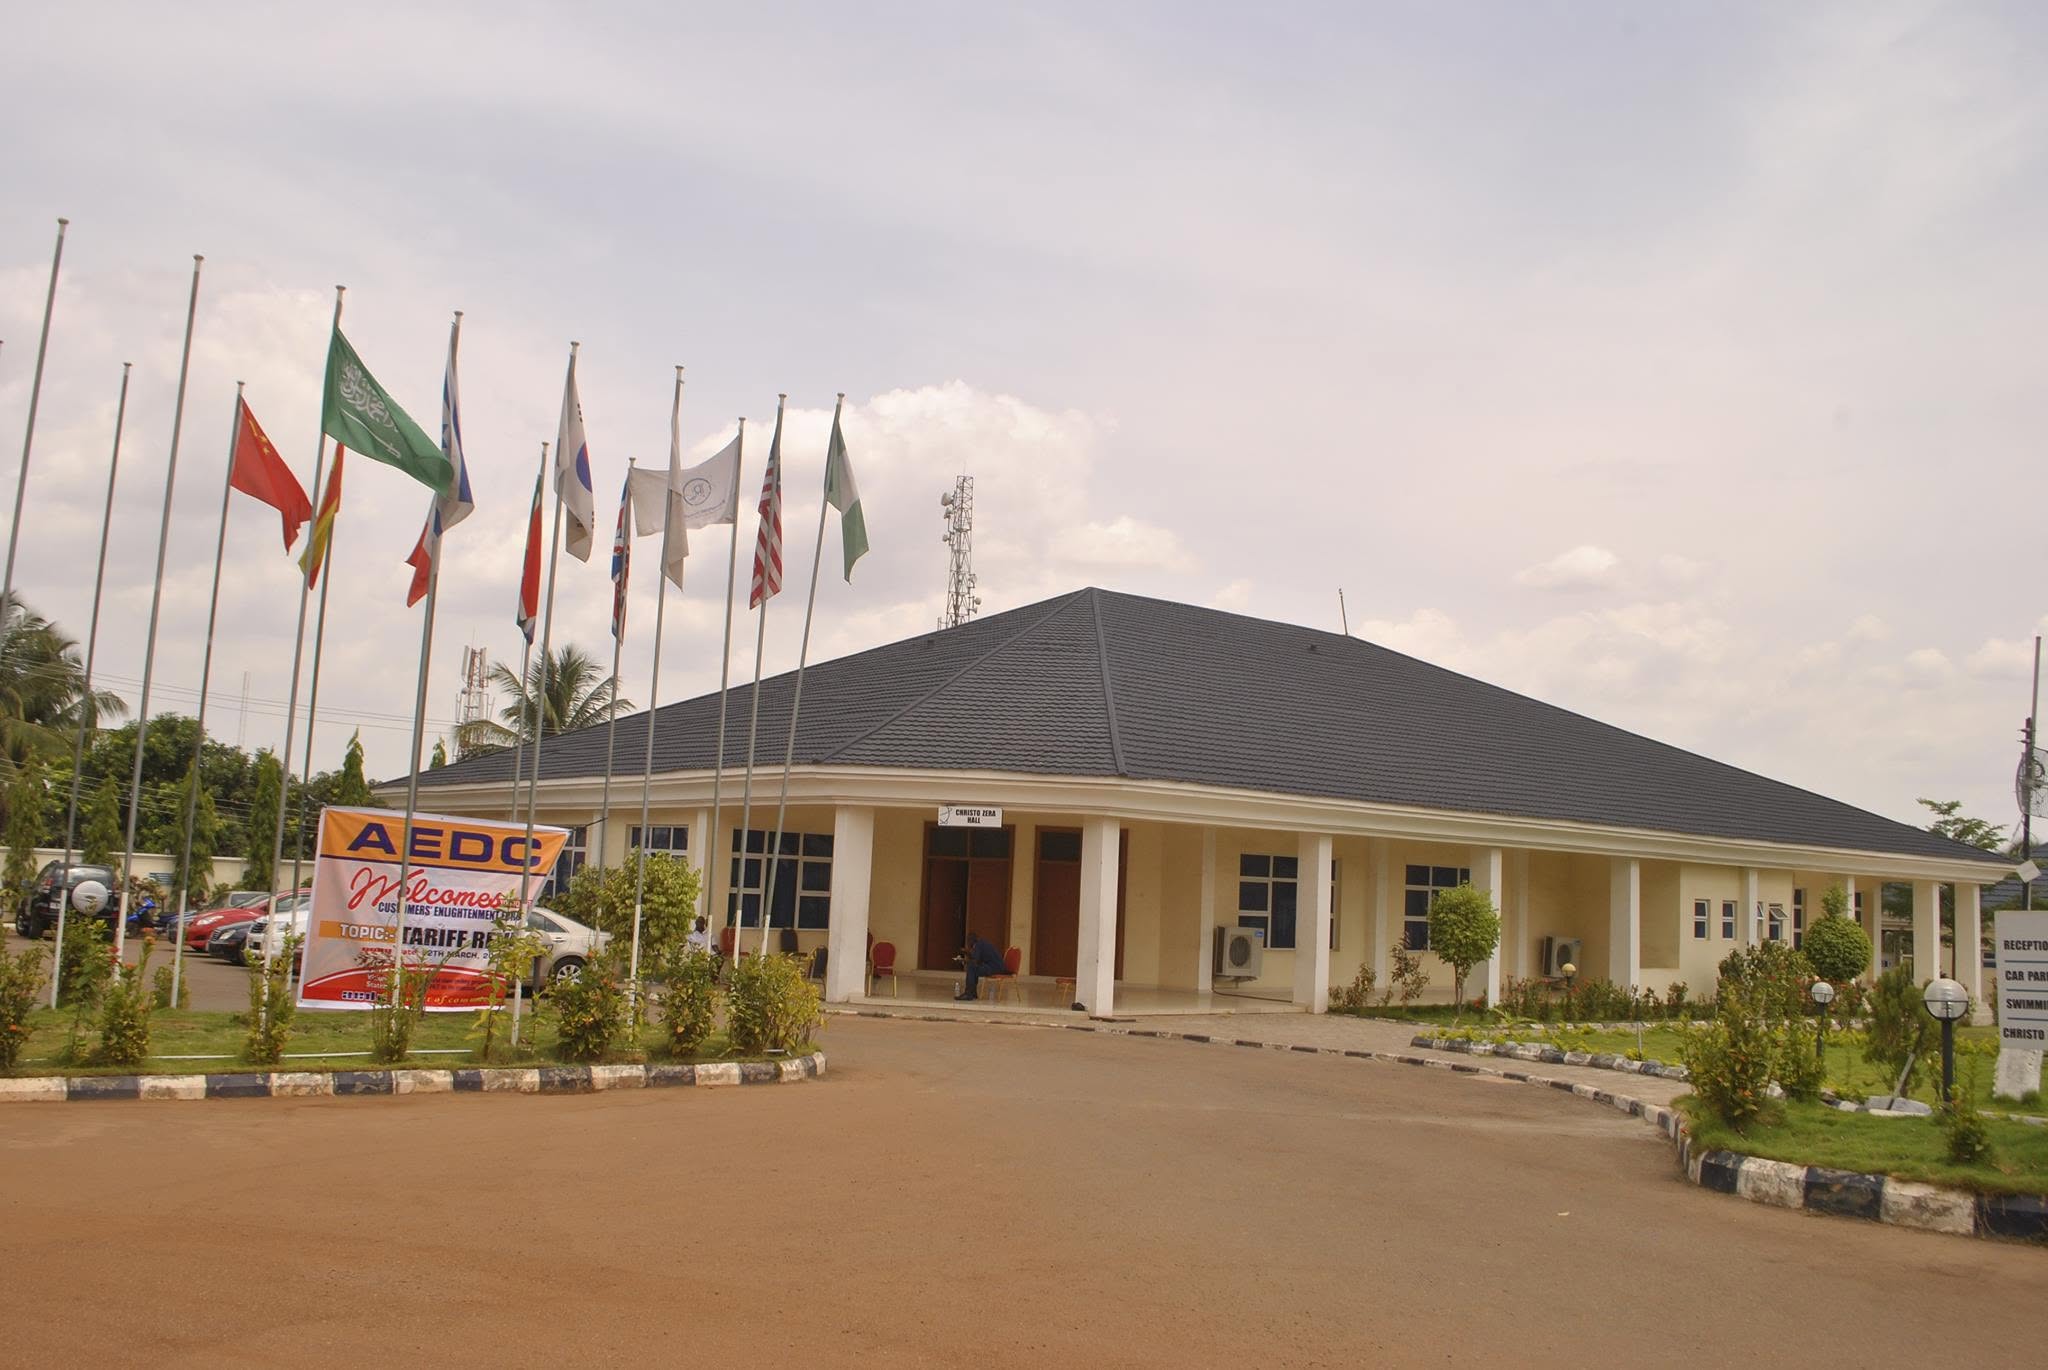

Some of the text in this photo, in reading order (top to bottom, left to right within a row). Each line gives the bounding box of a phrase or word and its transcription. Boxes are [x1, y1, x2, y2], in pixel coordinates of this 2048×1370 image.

[955, 809, 981, 817] CHRISTO
[967, 816, 981, 824] HALL
[347, 822, 542, 867] AEDC
[378, 901, 432, 916] CUSMERS'
[402, 926, 469, 948] TARIFF
[2005, 970, 2048, 981] CAR PAR
[2006, 998, 2048, 1010] SWIMMI
[2003, 1027, 2045, 1040] CHRISTO
